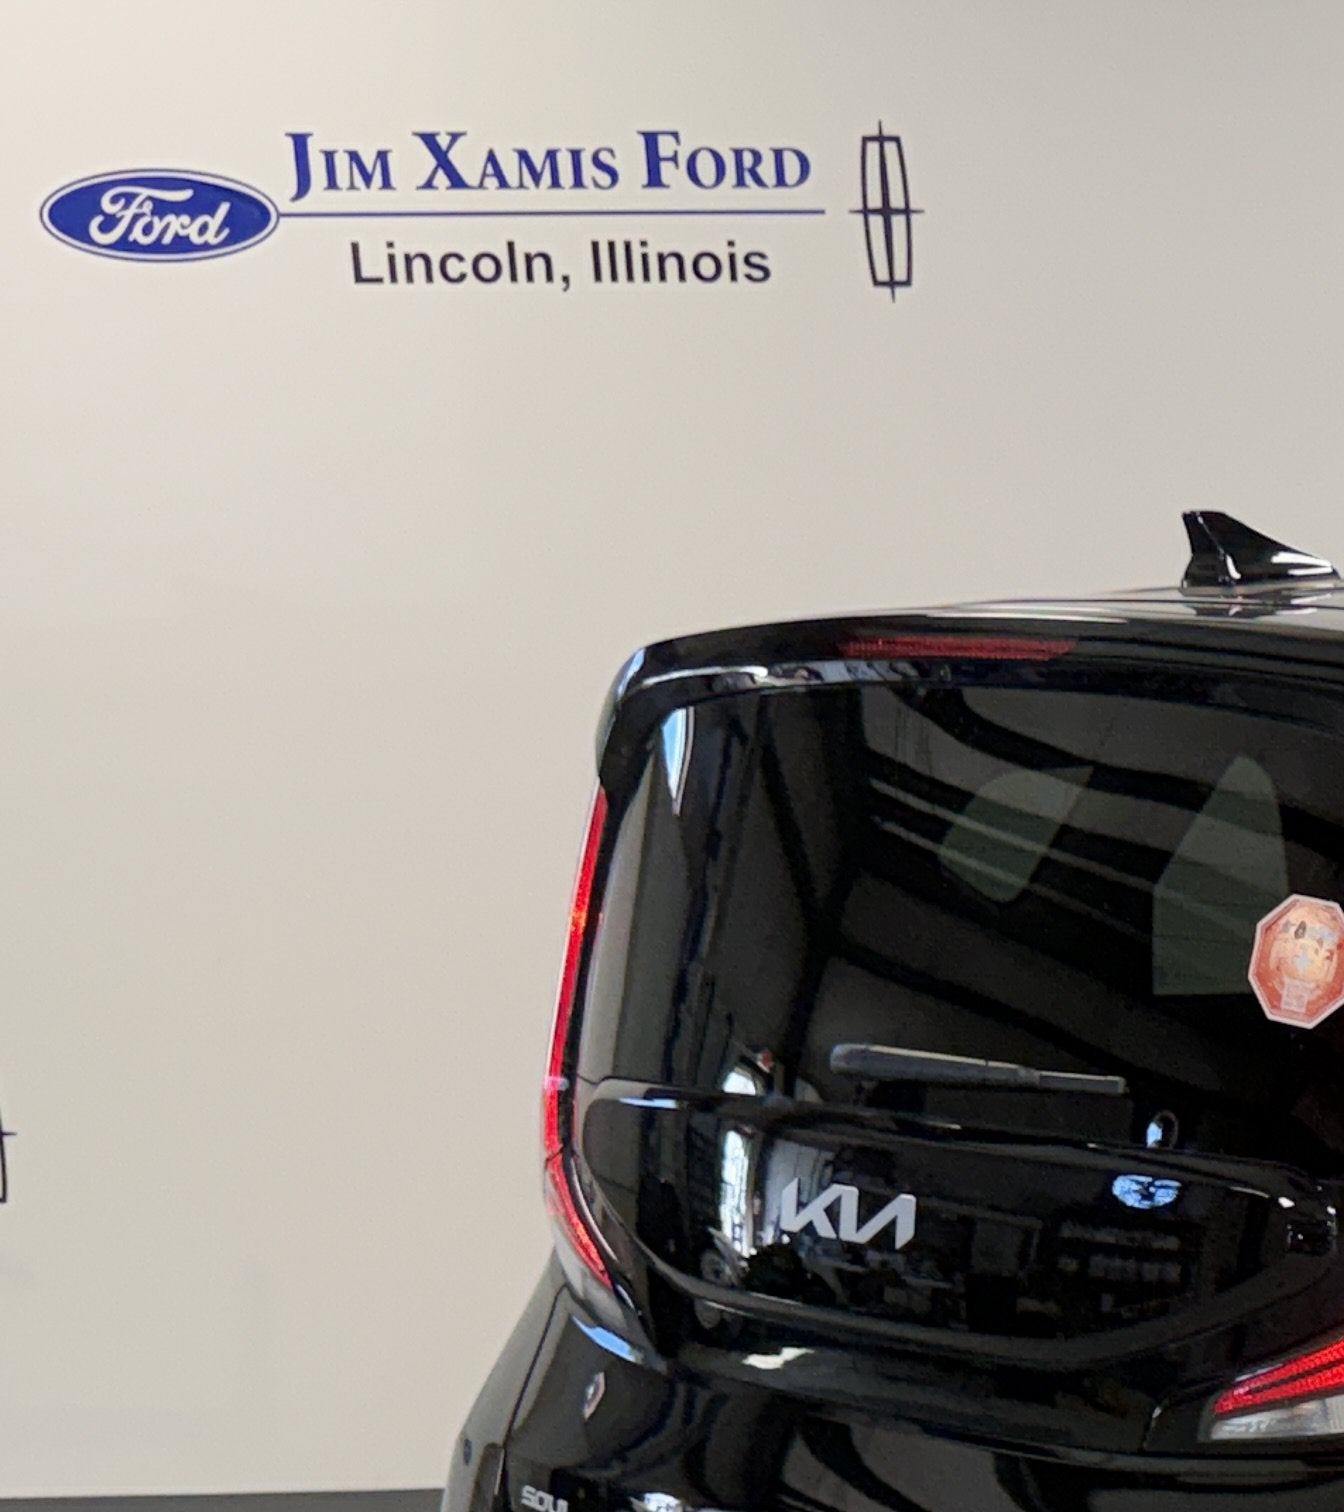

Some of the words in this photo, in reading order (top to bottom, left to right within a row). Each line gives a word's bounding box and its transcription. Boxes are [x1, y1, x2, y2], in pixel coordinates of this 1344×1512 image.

[286, 130, 395, 203] JIM
[412, 131, 620, 190] XAMIS
[637, 130, 812, 189] FORD
[88, 185, 232, 246] Ford
[352, 241, 571, 292] Lincoln,
[592, 240, 771, 283] Illinois
[779, 1177, 917, 1250] KIA
